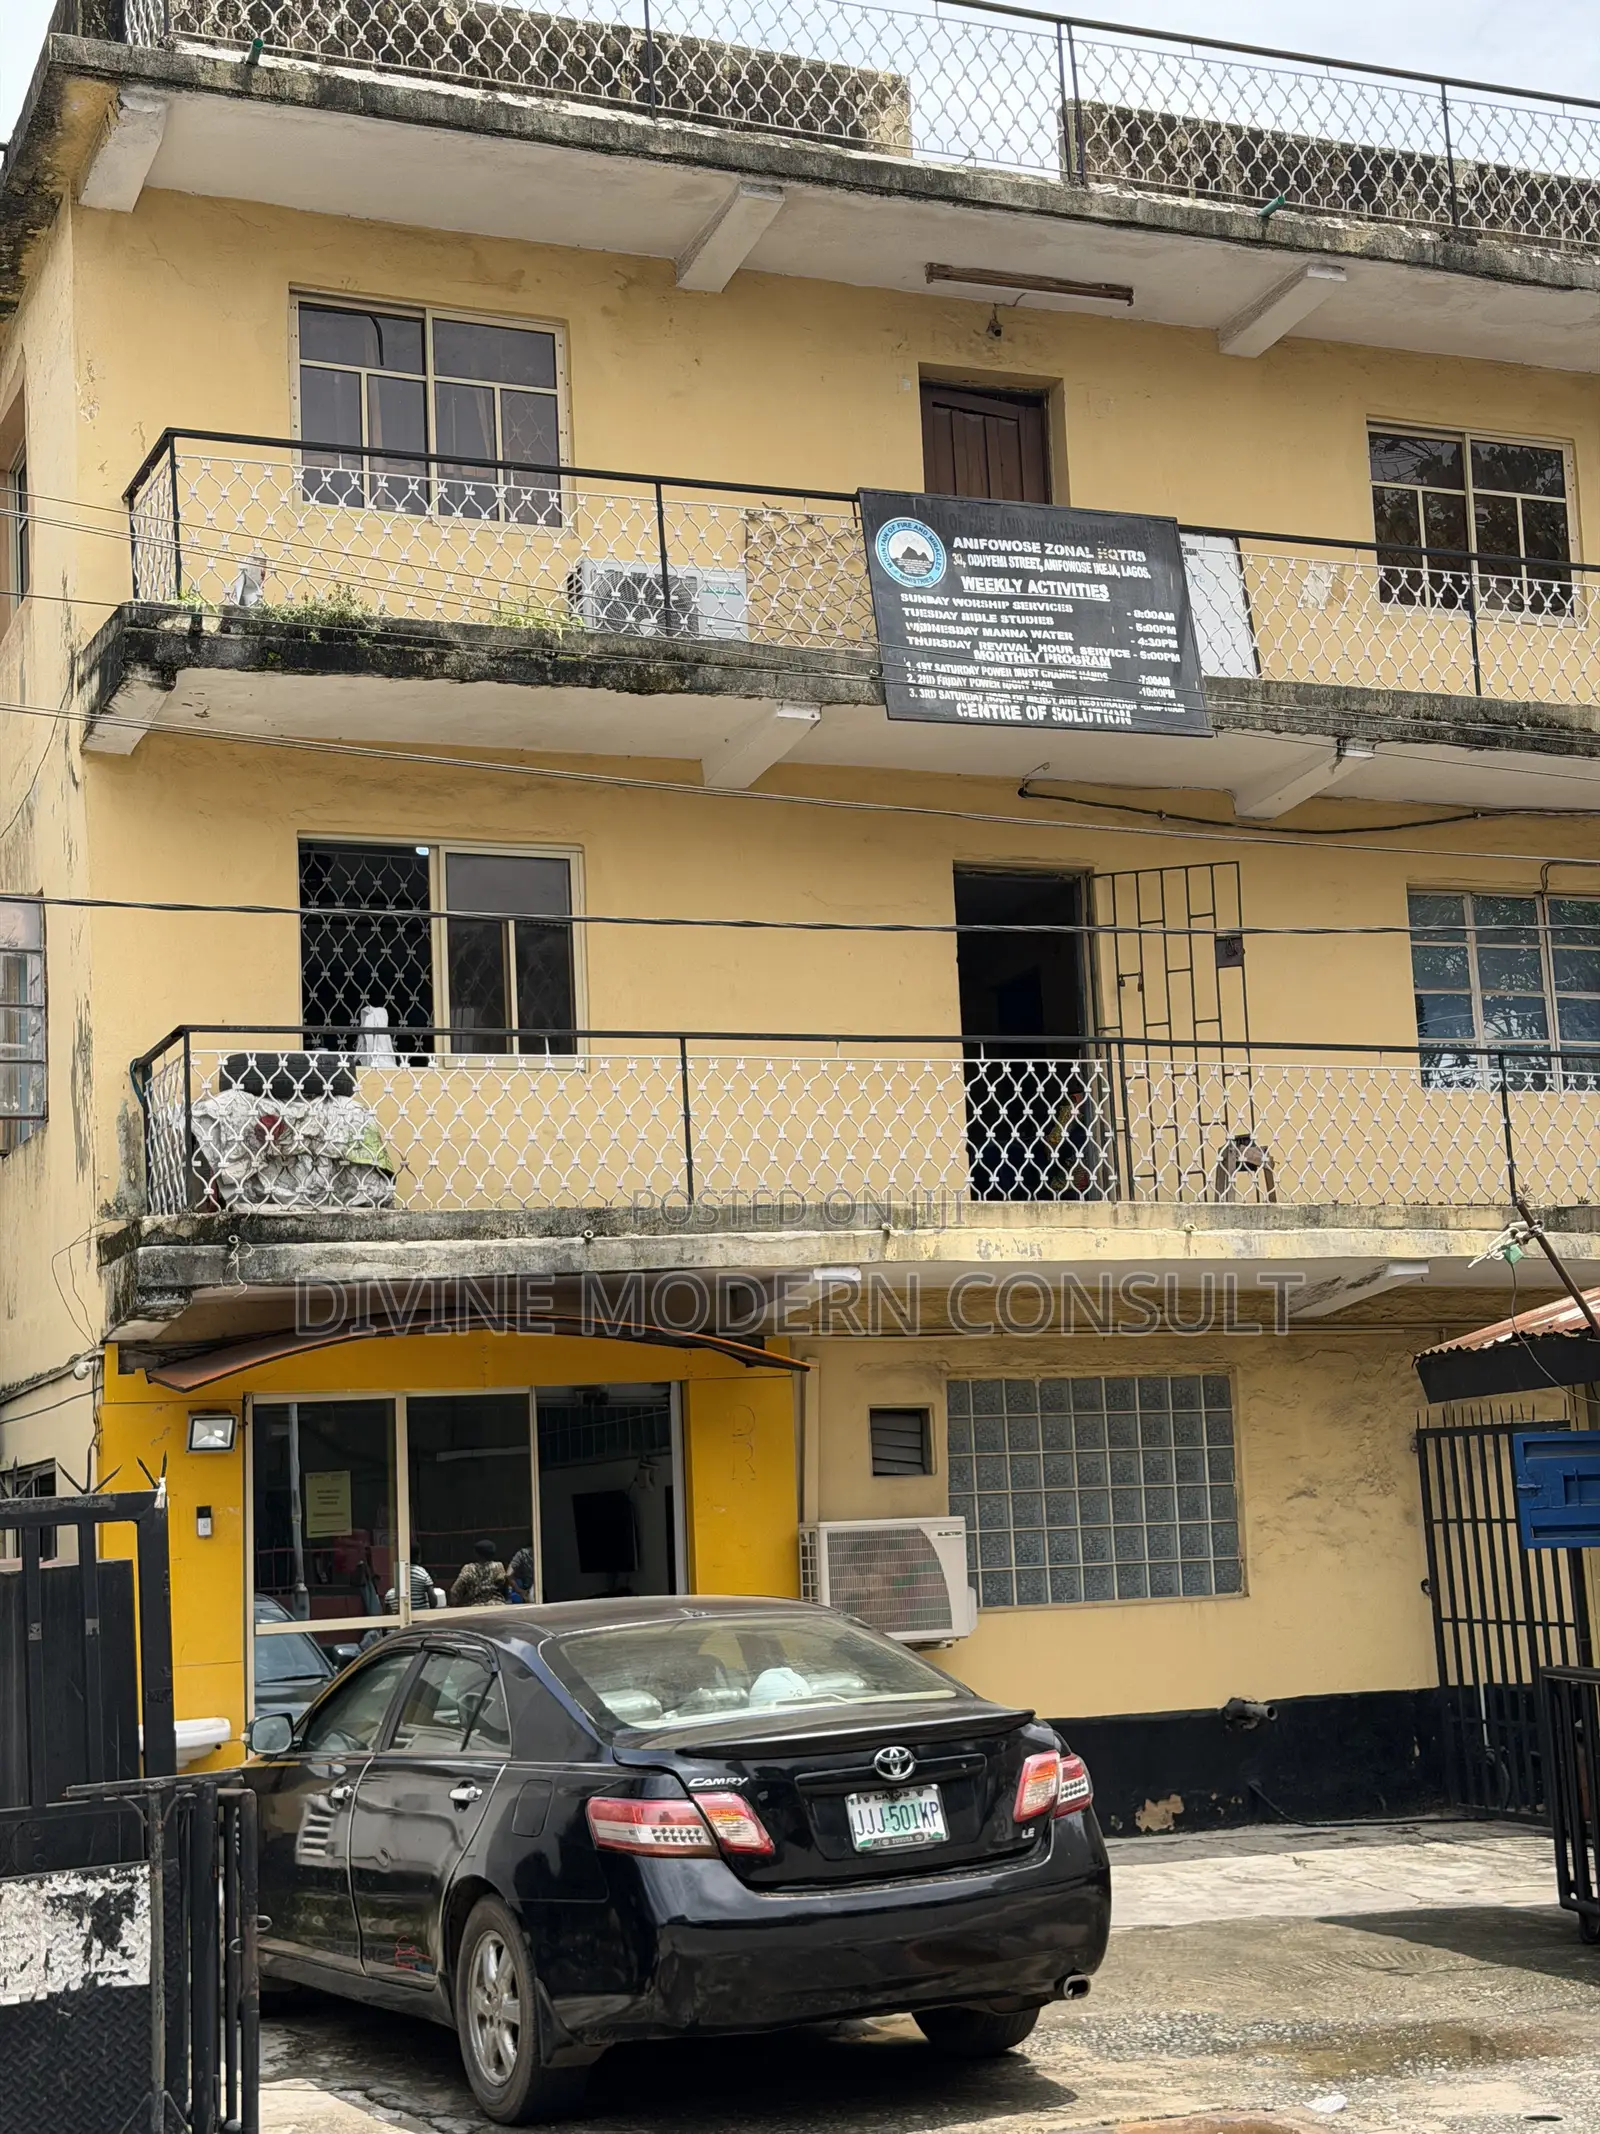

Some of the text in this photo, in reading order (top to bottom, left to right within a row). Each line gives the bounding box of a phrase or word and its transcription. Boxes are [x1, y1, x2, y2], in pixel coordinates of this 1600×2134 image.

[887, 524, 896, 533] OF
[914, 524, 928, 536] AND
[881, 532, 894, 569] MOUNTAIN
[928, 535, 942, 571] MIRACLES
[952, 537, 1042, 553] ANIFOWOSE
[1044, 543, 1094, 558] ZONAL
[1044, 559, 1093, 574] ANIFOWOSE
[1121, 566, 1152, 579] LAGOS.
[961, 576, 1110, 599] WEEKLY ACTIVITIES
[900, 593, 949, 606] SUNDAY
[952, 597, 1010, 610] WORSHIP
[1012, 601, 1074, 613] SERVICES
[902, 607, 958, 620] TUESDAY
[961, 612, 998, 623] BIBLE
[1000, 615, 1054, 626] STUDIES
[905, 622, 979, 636] WEDNESDAY
[982, 627, 1028, 638] MANNA
[1030, 629, 1075, 641] WATER
[906, 636, 972, 649] THURSDAY
[978, 641, 1032, 652] REVIVAL
[1037, 644, 1074, 655] HOUR
[1079, 646, 1131, 658] SERVICE
[973, 649, 1112, 668] MONTHLY PROGRAM
[934, 663, 979, 676] SATURDAY
[981, 666, 1013, 677] POWER
[1013, 668, 1039, 678] MUST
[917, 674, 935, 685] 2ND
[936, 675, 969, 687] FRIDAY
[969, 677, 1001, 689] POWER
[919, 688, 937, 698] 3RD
[957, 702, 1132, 725] CENTRE OF SOLUTION
[687, 1776, 749, 1787] CAMRY
[1021, 1827, 1036, 1839] LE
